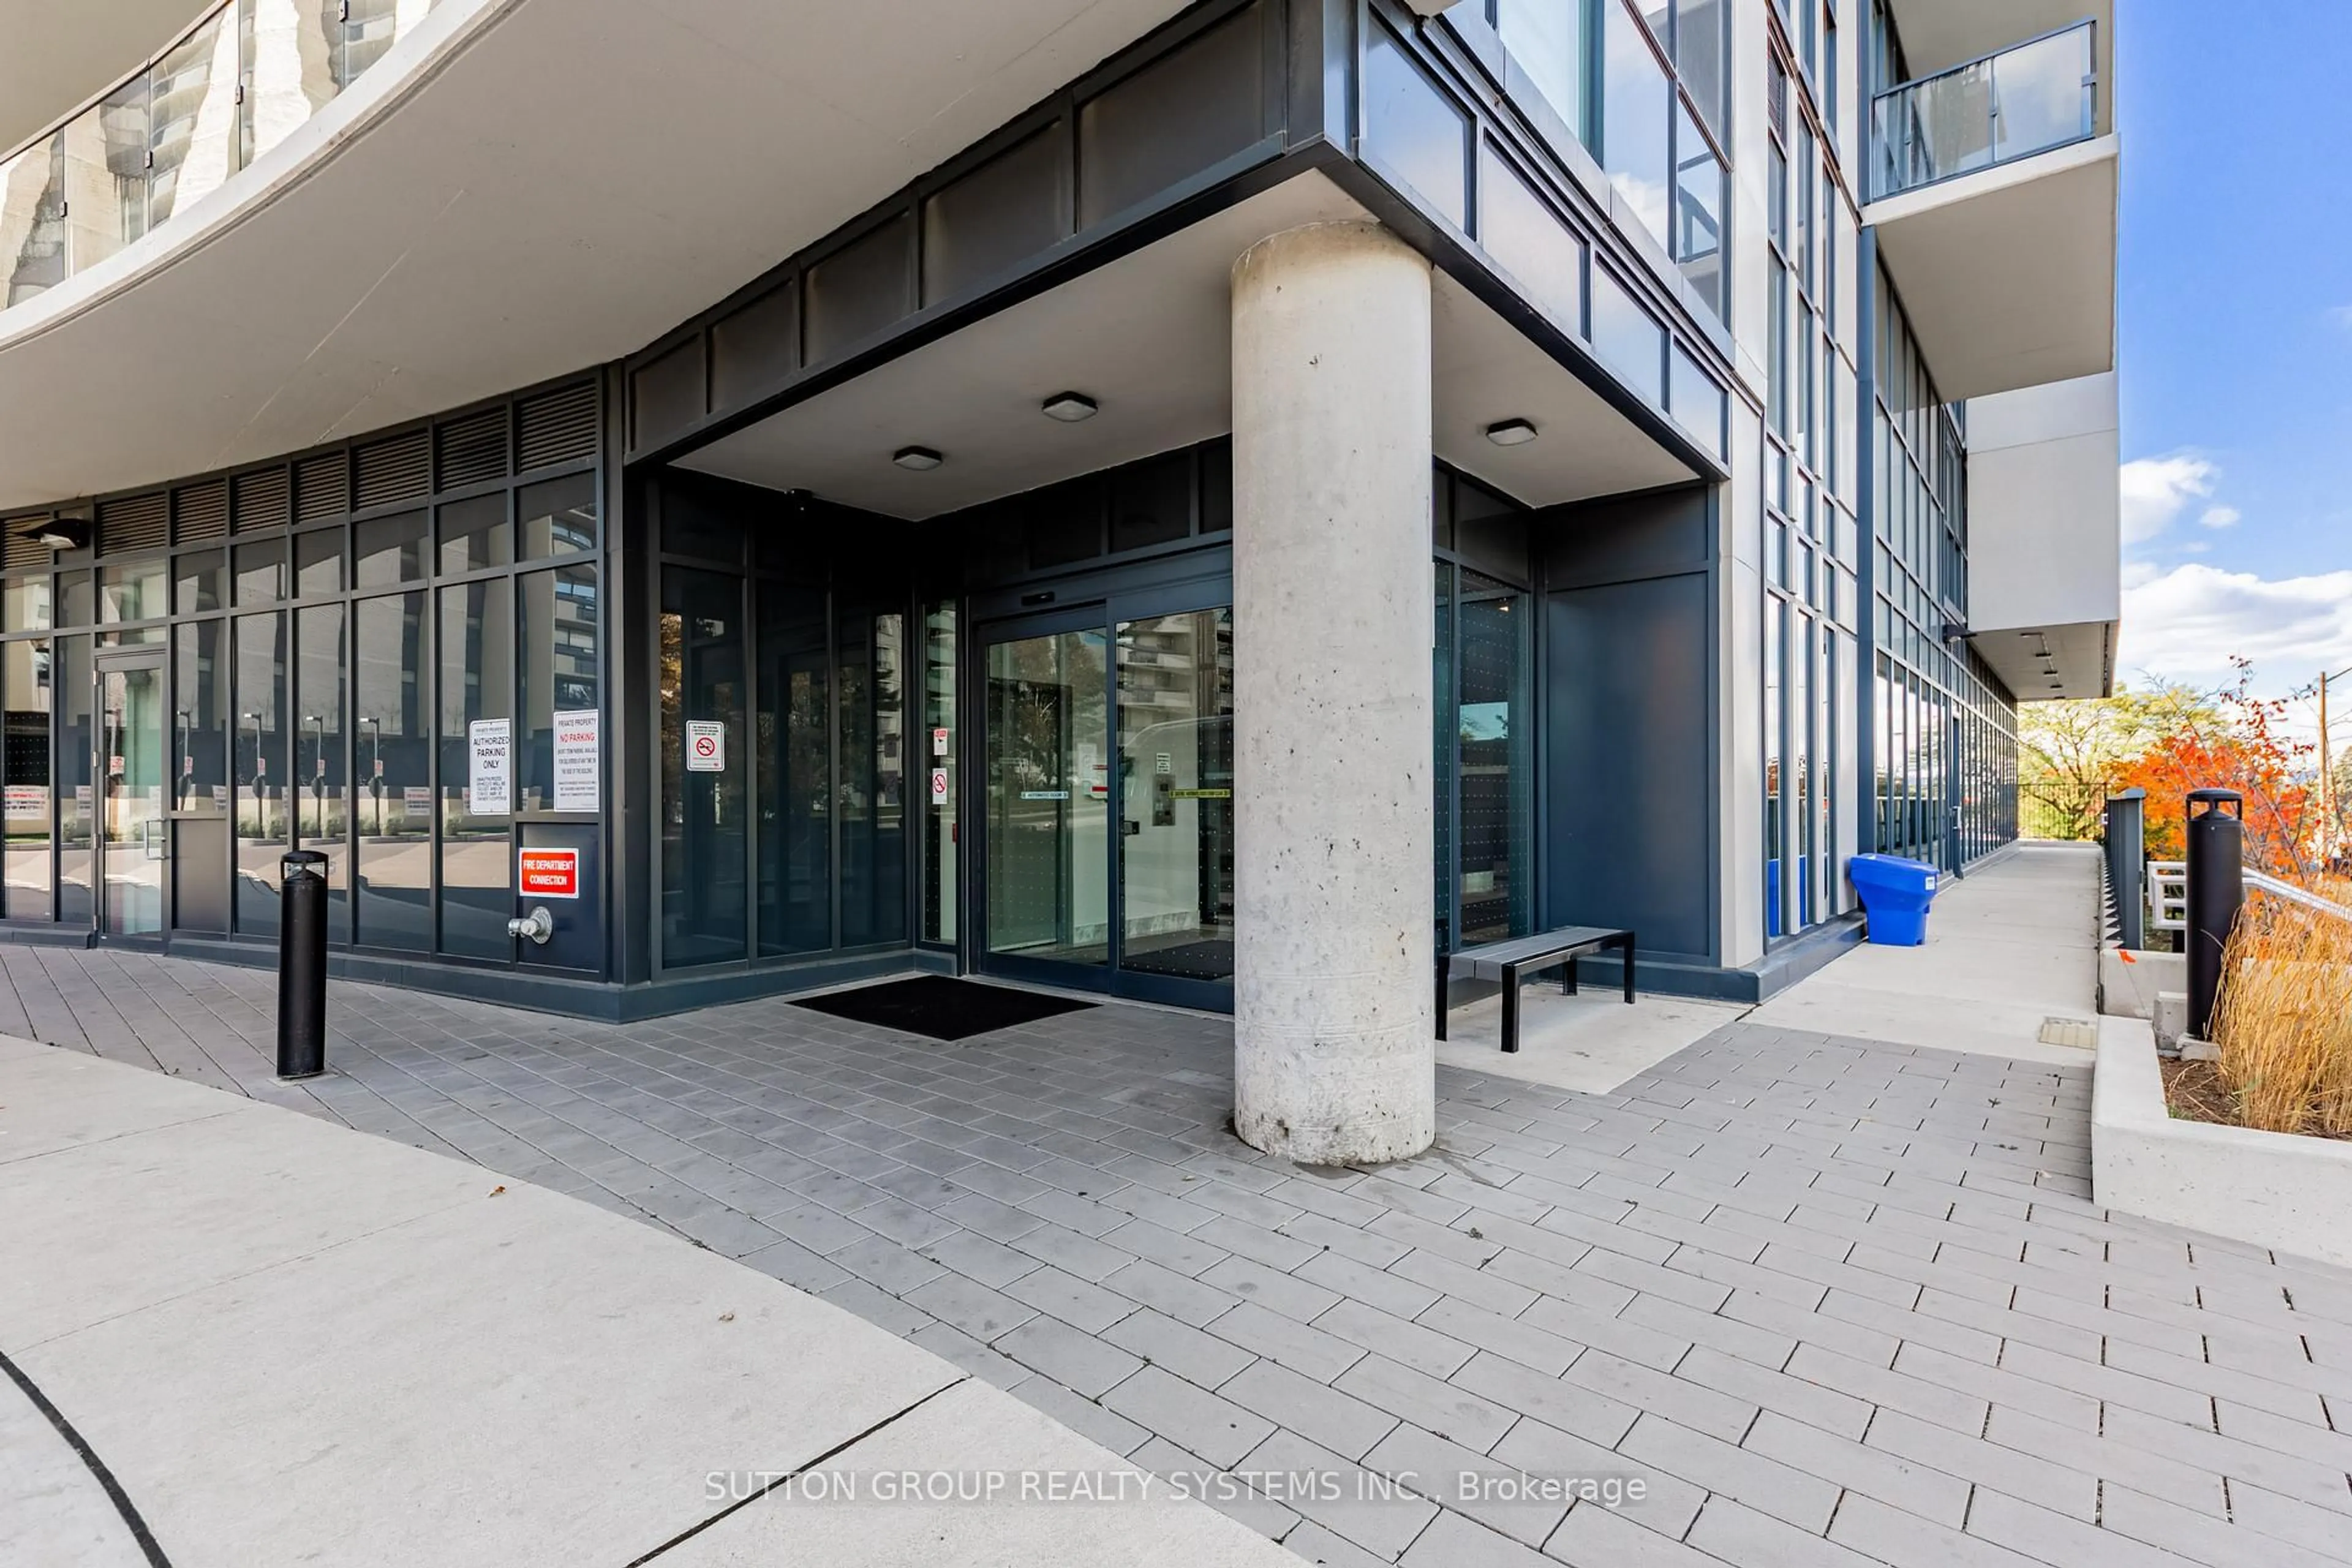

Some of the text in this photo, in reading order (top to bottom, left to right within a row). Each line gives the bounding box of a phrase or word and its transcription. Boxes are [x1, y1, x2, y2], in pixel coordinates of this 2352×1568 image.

[473, 736, 510, 746] AUTHORIZED
[560, 732, 595, 743] NO PARKING
[477, 748, 506, 758] PARKING
[483, 760, 500, 769] ONLY
[523, 859, 575, 870] FIRE DEPARTMENT
[529, 875, 568, 886] CONNECTION
